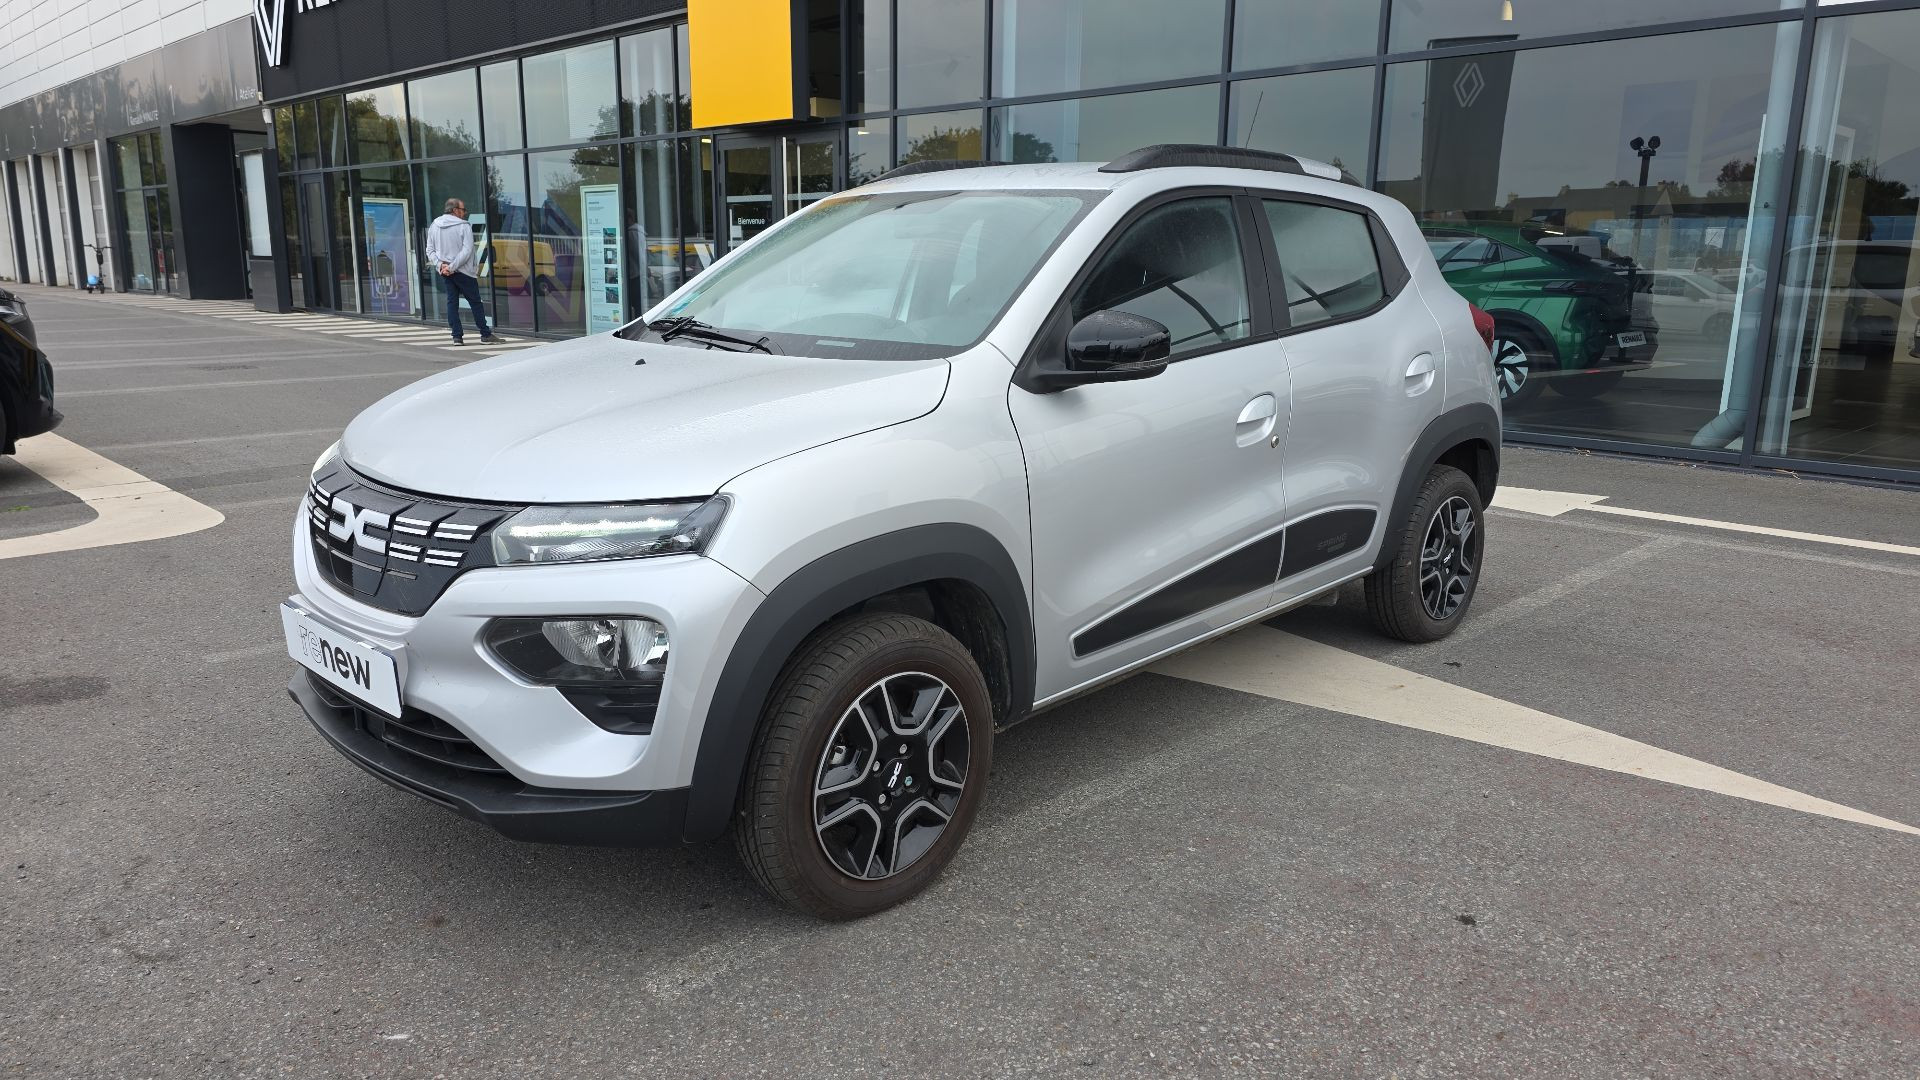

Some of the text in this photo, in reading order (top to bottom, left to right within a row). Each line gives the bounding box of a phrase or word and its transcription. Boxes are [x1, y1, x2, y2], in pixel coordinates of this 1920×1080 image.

[738, 217, 766, 225] Bienvenue
[1622, 334, 1643, 345] RENAULT
[298, 624, 371, 691] renew
